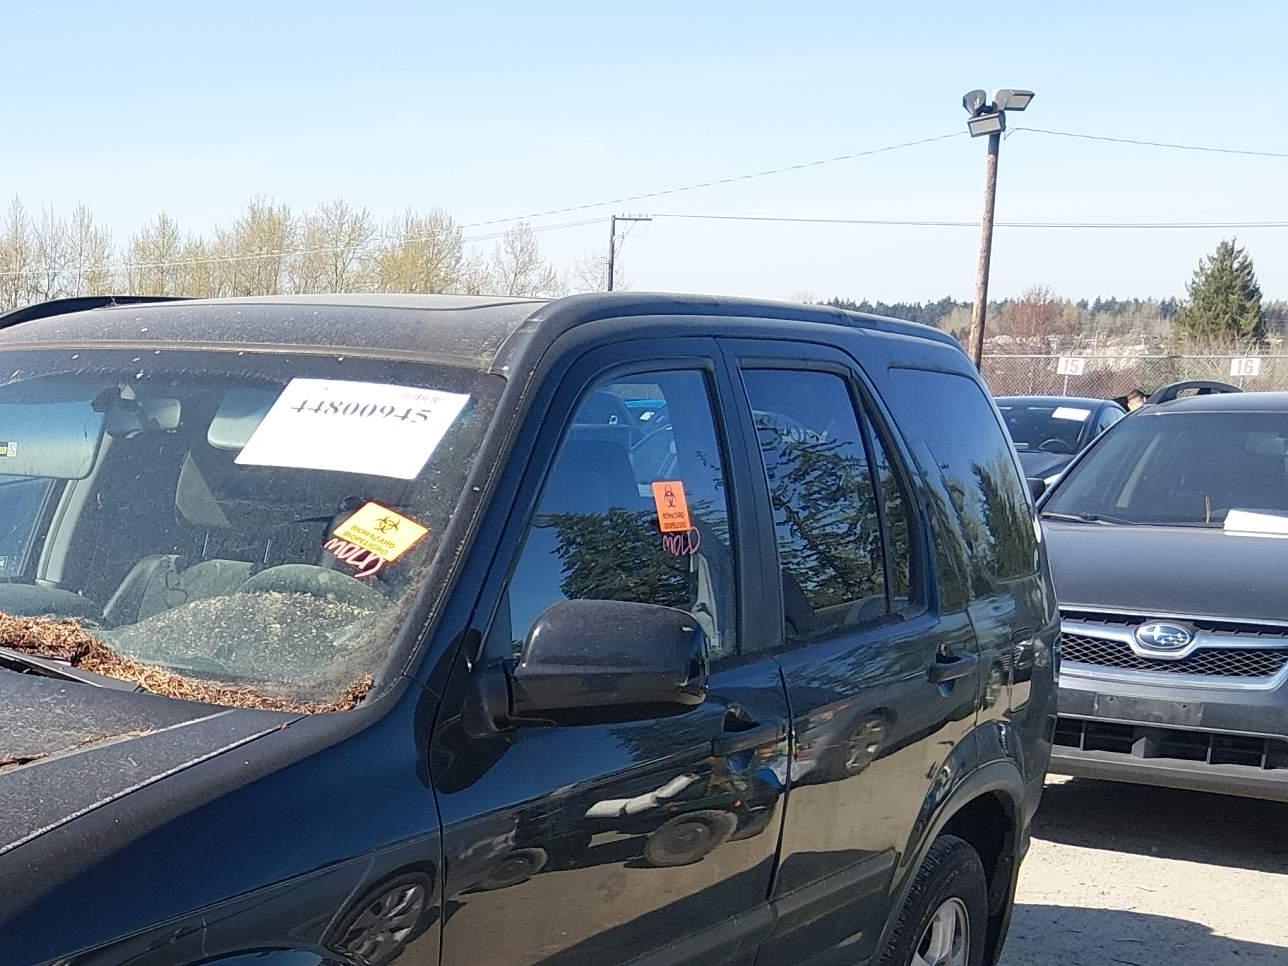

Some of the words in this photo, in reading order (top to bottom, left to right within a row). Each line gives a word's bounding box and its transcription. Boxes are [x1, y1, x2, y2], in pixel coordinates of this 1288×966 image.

[1063, 359, 1079, 373] 15
[1237, 359, 1254, 374] 16
[291, 400, 432, 423] 44800945
[350, 525, 396, 549] BIOHAZARD
